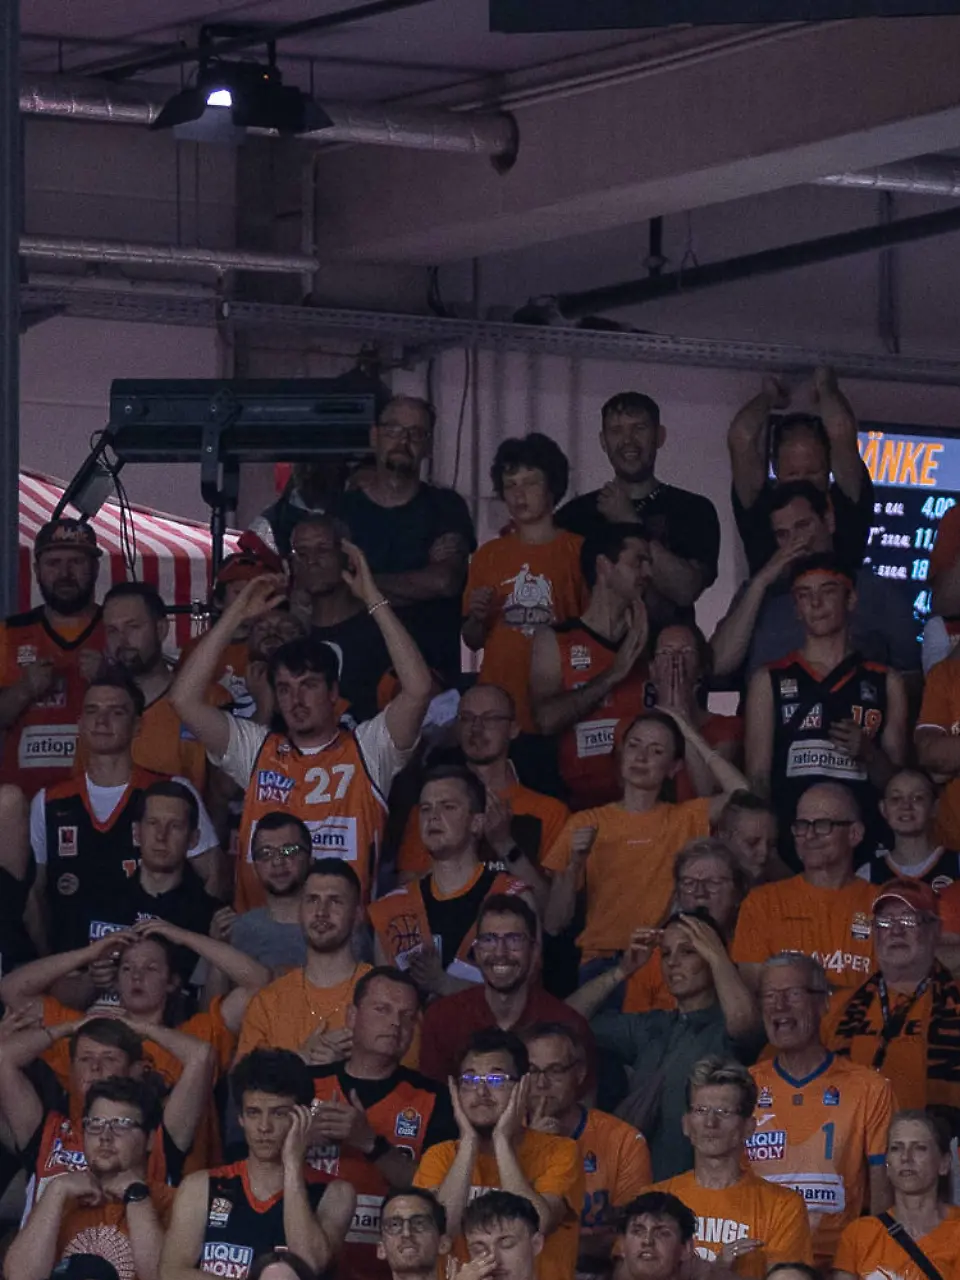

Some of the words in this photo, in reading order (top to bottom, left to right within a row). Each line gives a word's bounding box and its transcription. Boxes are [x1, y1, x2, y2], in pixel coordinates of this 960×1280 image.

[26, 737, 76, 757] ratiop
[304, 764, 356, 804] 27
[311, 831, 345, 848] arm
[820, 1122, 836, 1160] 1
[692, 1216, 750, 1244] ANGE
[203, 1243, 252, 1266] LIQUI
